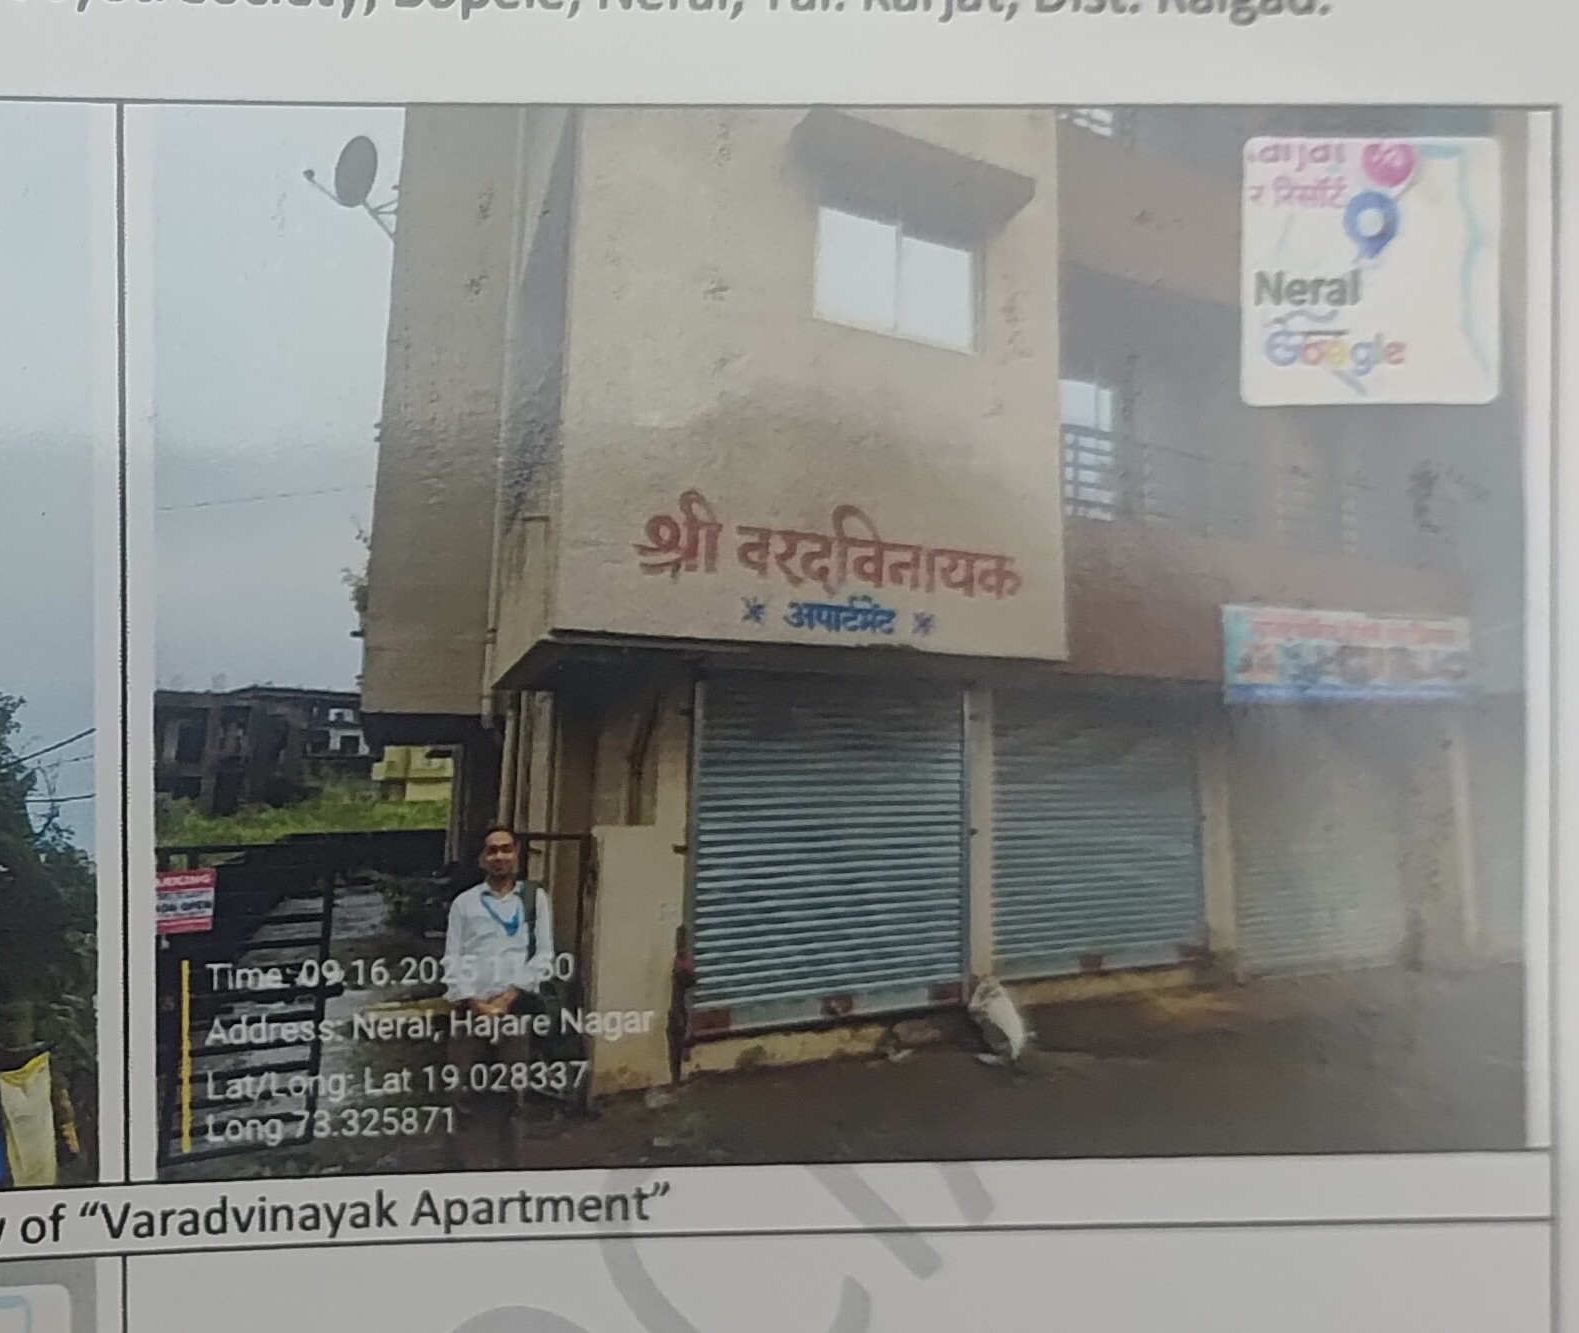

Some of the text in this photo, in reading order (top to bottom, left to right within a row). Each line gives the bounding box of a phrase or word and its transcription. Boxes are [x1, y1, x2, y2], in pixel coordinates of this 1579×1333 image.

[633, 489, 722, 582] श्री
[21, 1202, 68, 1245] of
[78, 1189, 397, 1239] “Varadvinayak
[409, 1181, 671, 1234] Apartment”
